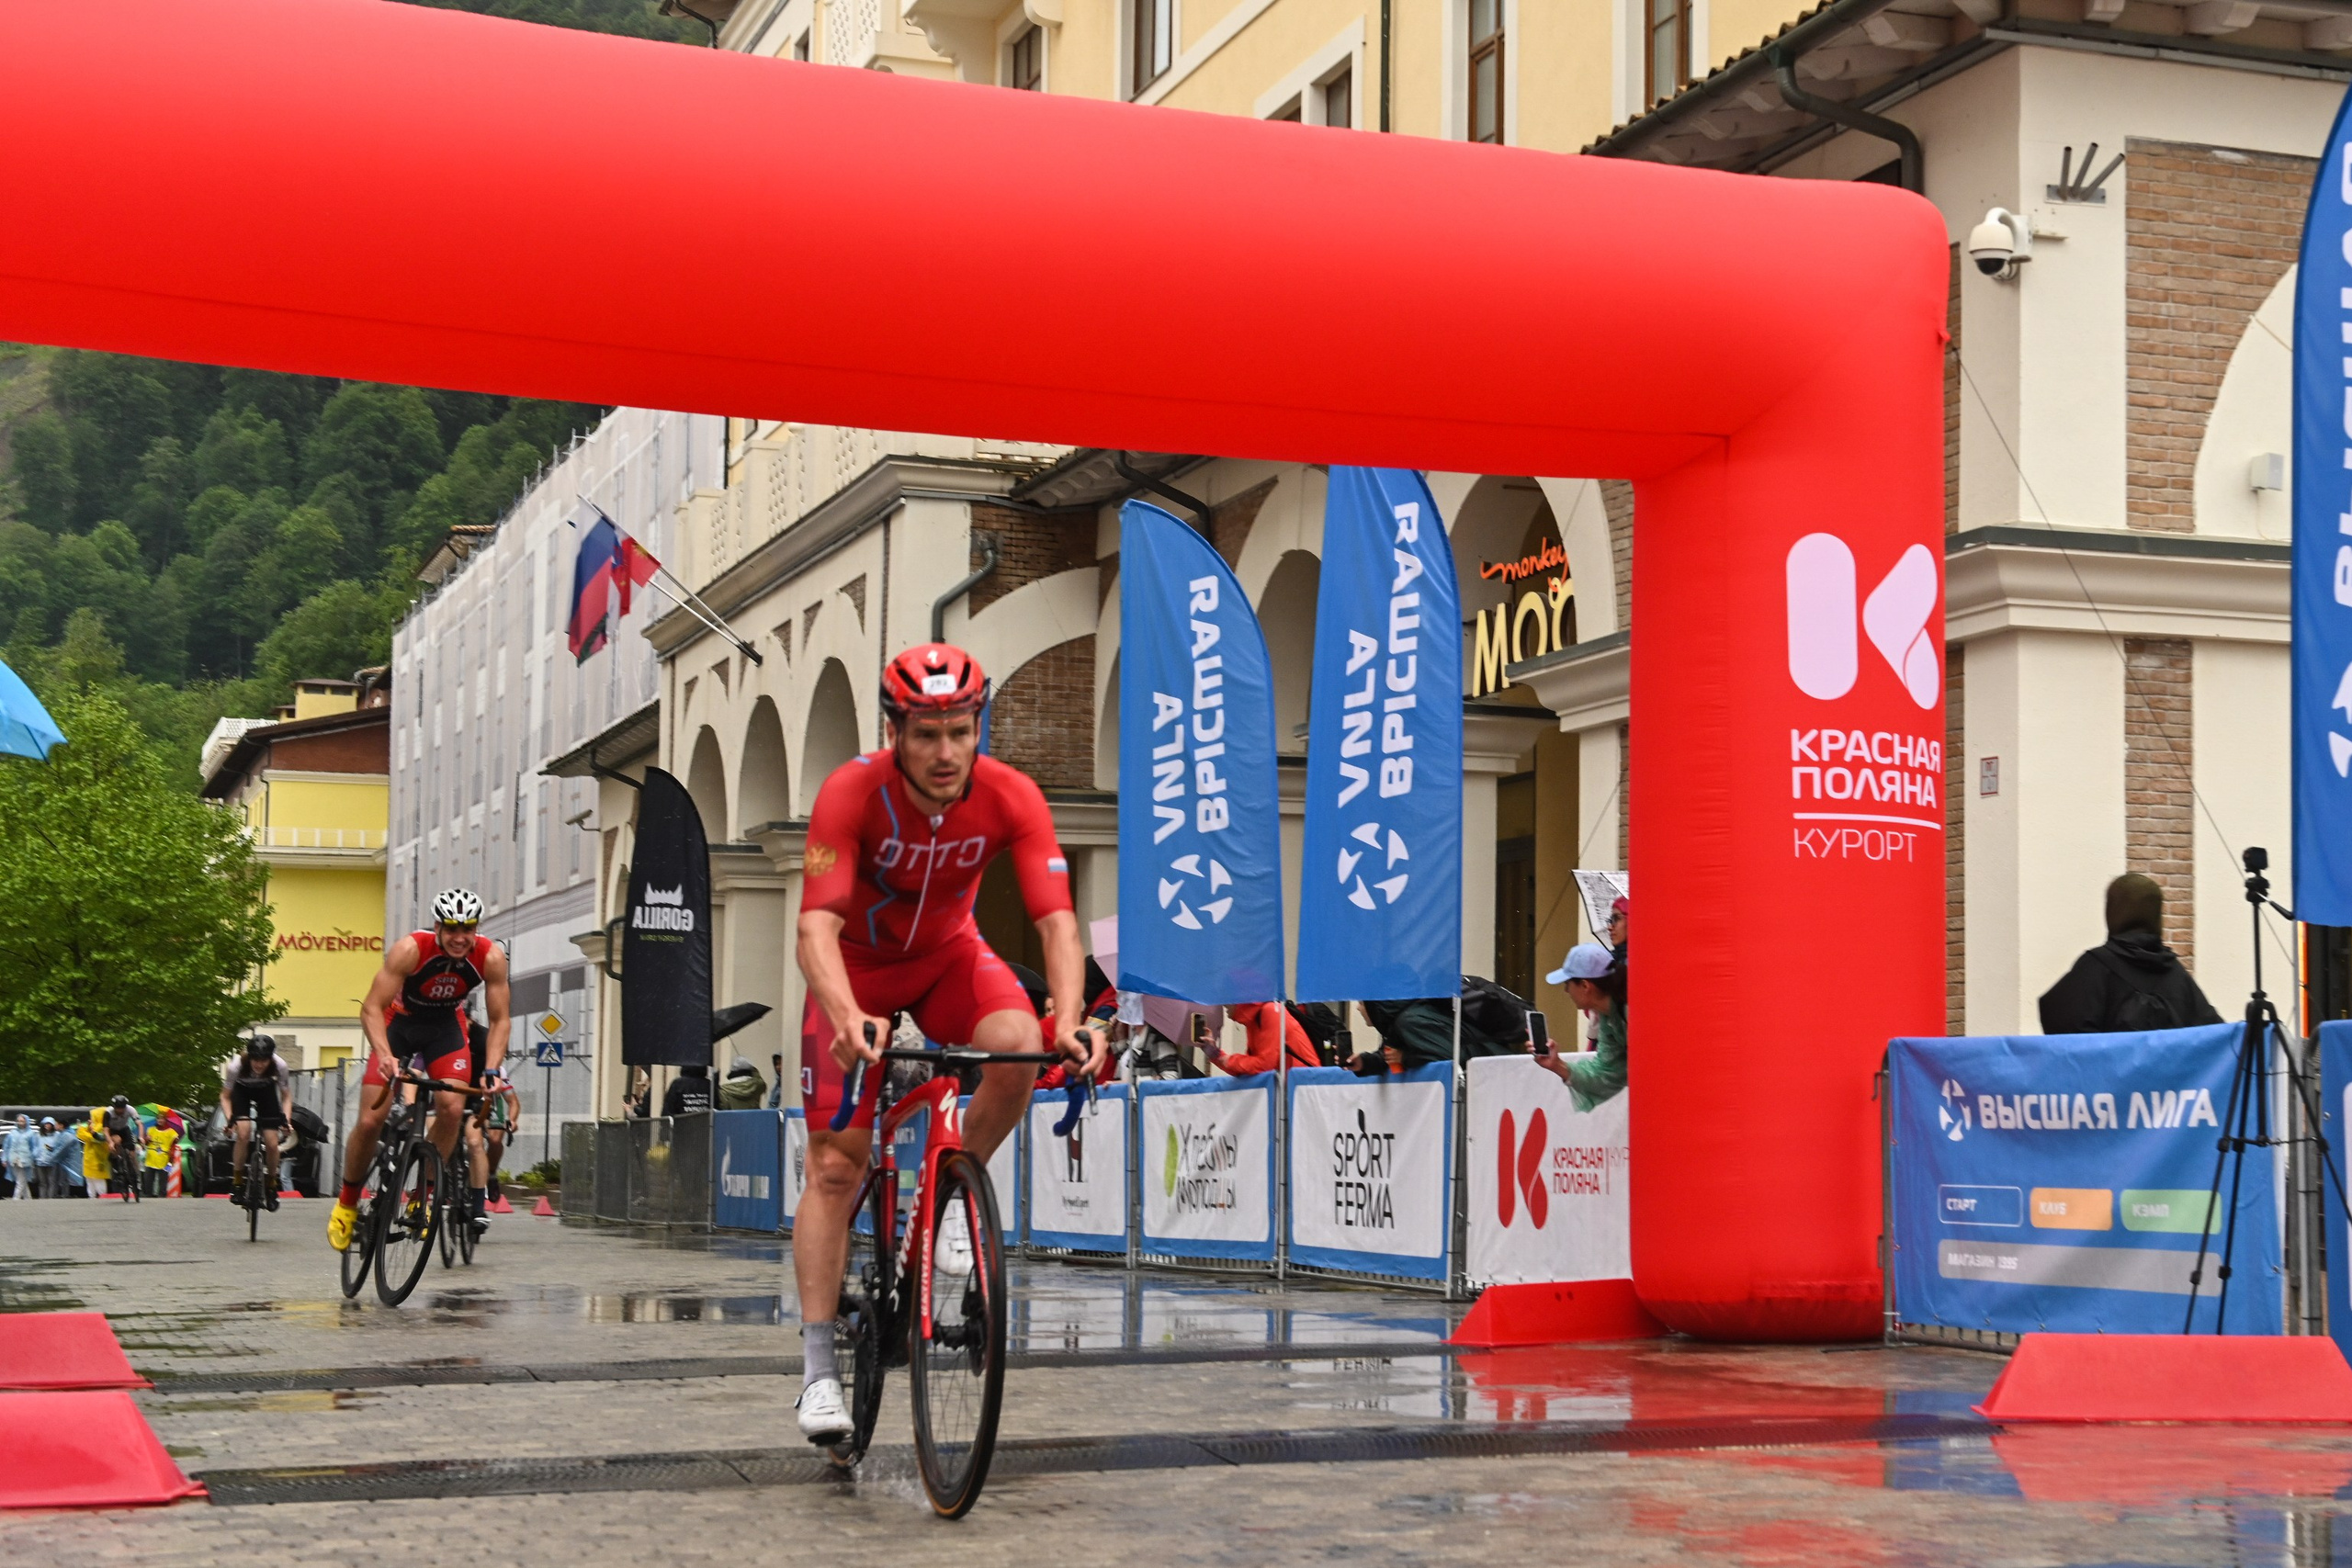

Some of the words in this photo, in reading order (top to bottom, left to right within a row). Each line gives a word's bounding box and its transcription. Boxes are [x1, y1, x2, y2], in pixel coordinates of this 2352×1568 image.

[1480, 536, 1569, 592] monkey
[1791, 728, 1941, 773] КРАСНАЯ
[1792, 766, 1938, 809] ПОЛЯНА
[1793, 828, 1917, 863] КУРОРТ
[276, 931, 384, 952] MÖVENPIC
[1977, 1093, 2118, 1130] ВЫСШАЯ
[2127, 1089, 2219, 1129] ЛИГА
[1333, 1132, 1396, 1179] SPORT
[1553, 1146, 1603, 1169] КРАСНАЯ
[1553, 1172, 1600, 1195] ПОЛЯНА
[1335, 1180, 1396, 1230] FERMA
[1946, 1198, 1976, 1212] СТАРТ
